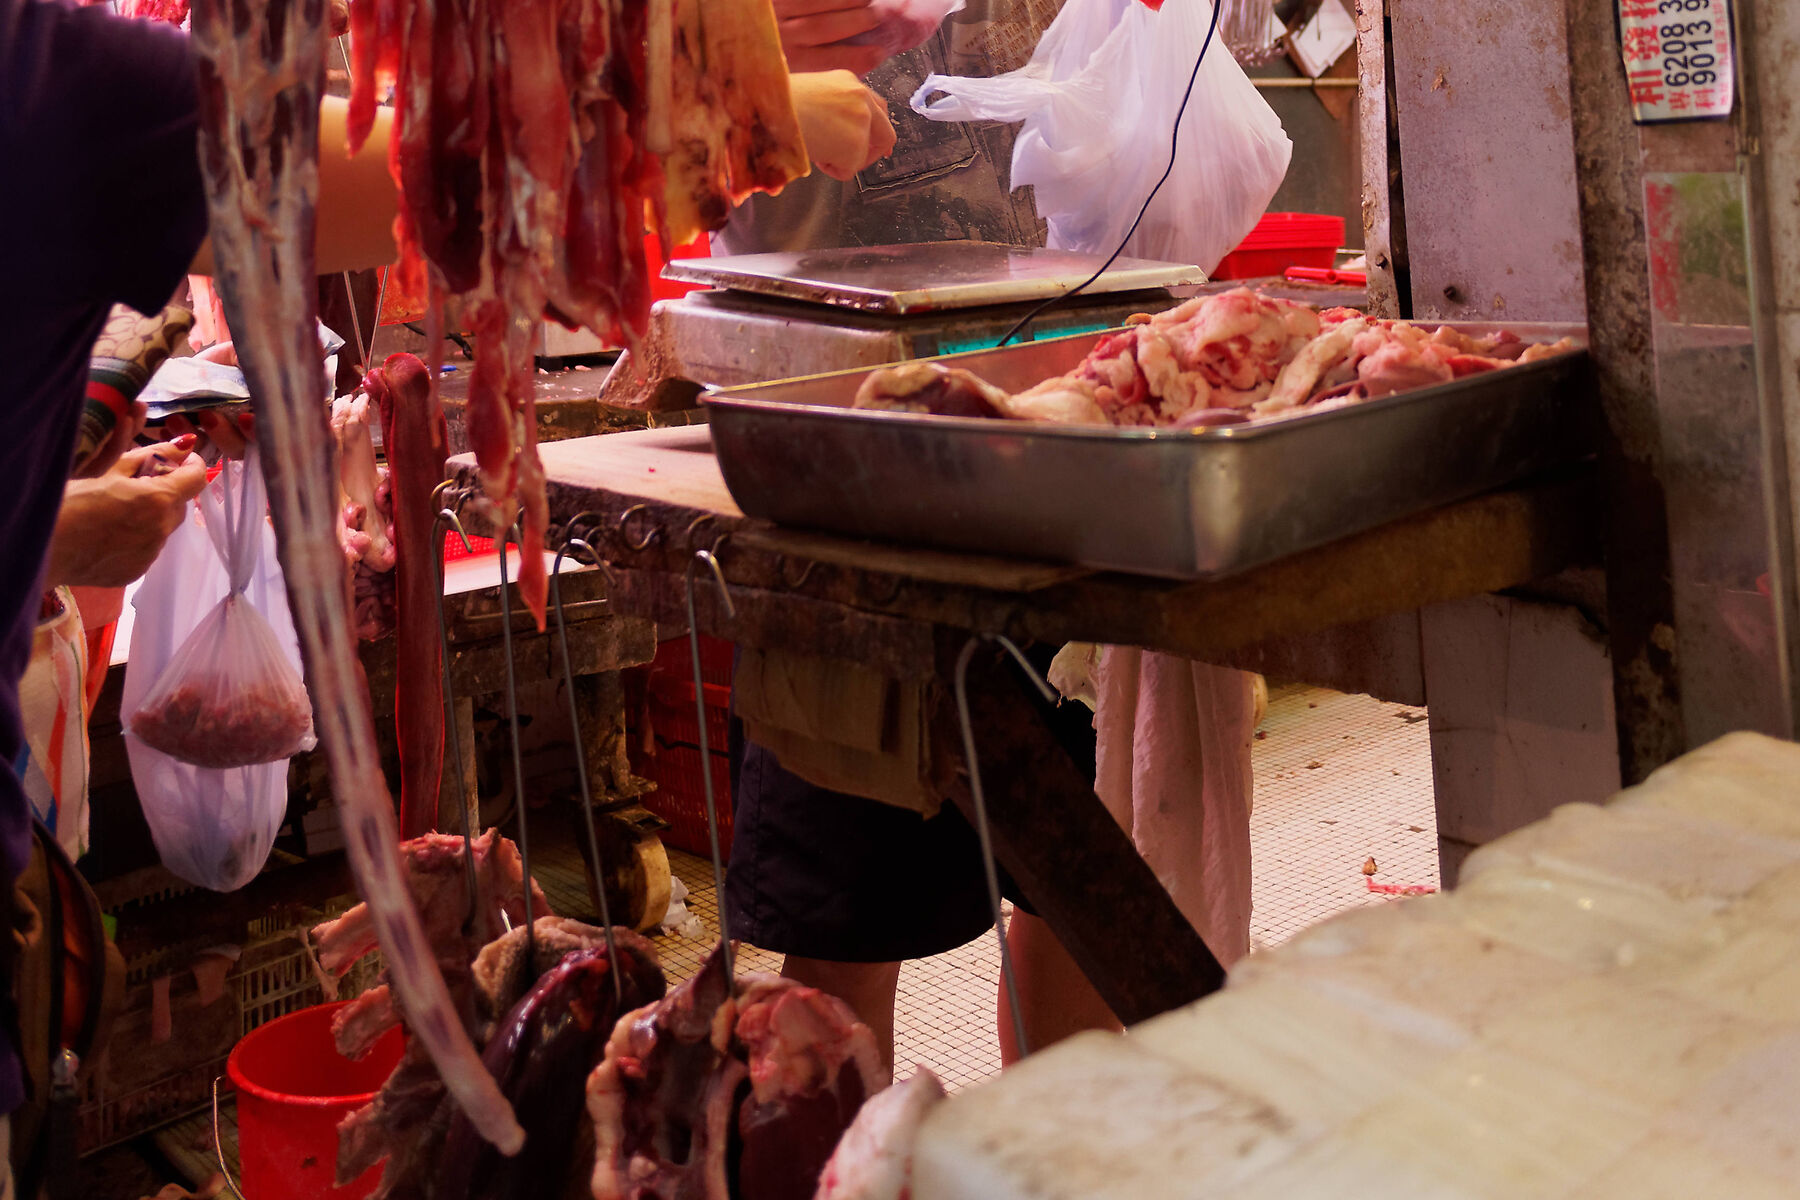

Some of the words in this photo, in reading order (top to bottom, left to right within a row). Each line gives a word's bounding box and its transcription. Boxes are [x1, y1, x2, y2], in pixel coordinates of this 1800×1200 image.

[1660, 23, 1690, 87] 6208
[1686, 20, 1716, 85] 9013
[1668, 88, 1716, 110] 專科
